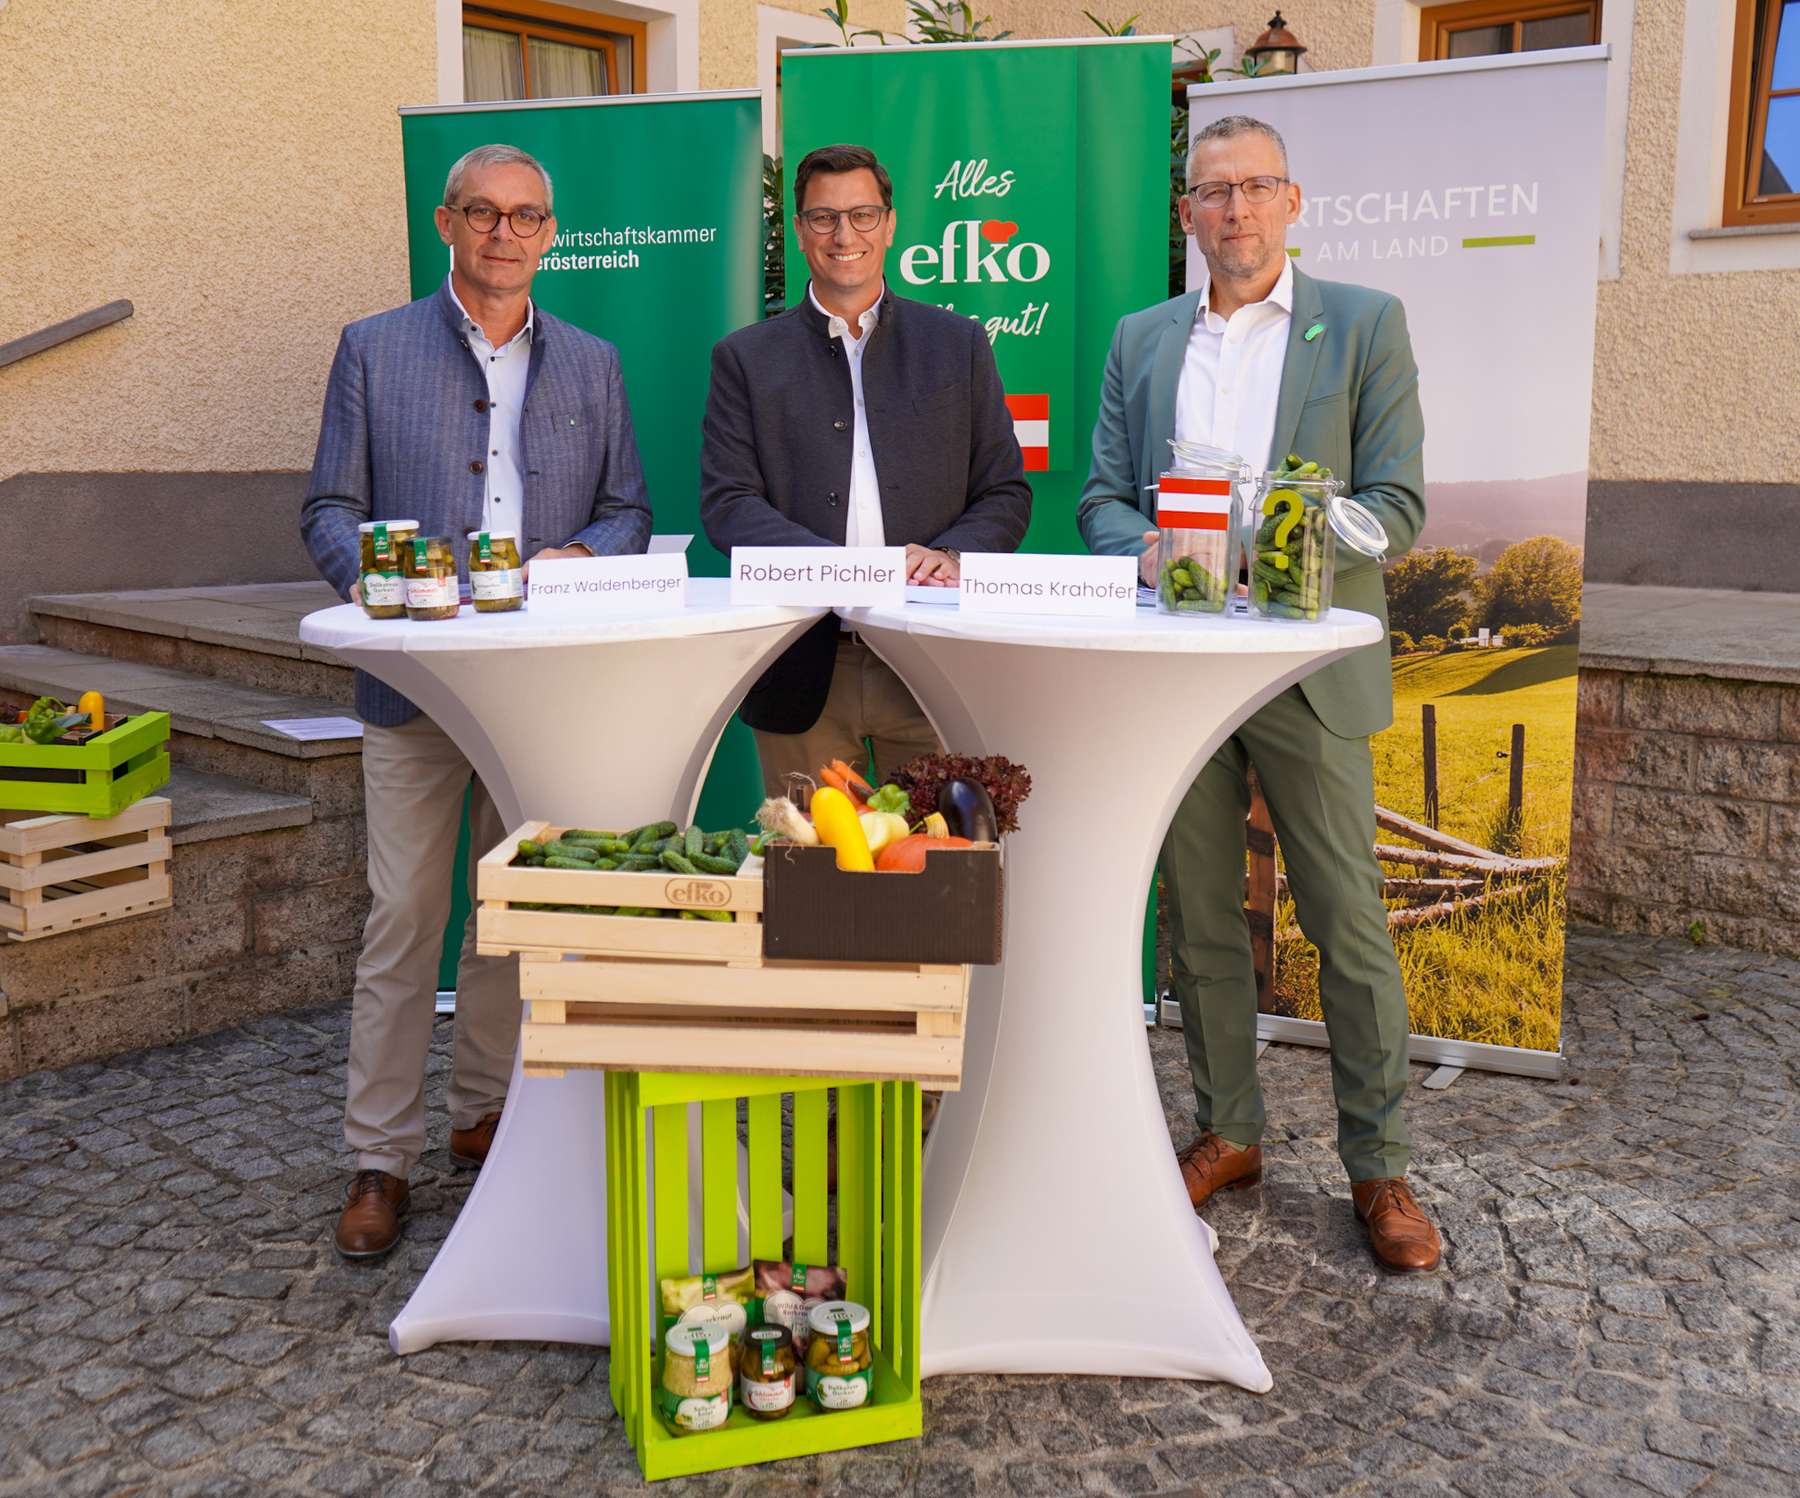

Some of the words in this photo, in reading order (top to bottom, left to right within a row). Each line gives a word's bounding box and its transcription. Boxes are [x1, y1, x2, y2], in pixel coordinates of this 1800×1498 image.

[933, 158, 1016, 201] Alles
[899, 219, 1051, 285] efko
[1316, 240, 1360, 263] AM
[1372, 235, 1449, 260] LAND
[984, 301, 1050, 347] gut!
[739, 562, 814, 583] Robert
[819, 562, 896, 584] Pichler
[531, 583, 569, 595] Franz
[574, 577, 682, 593] Waldenberger
[963, 577, 1044, 597] Thomas
[1050, 580, 1134, 600] Krahofer
[672, 881, 725, 904] efko
